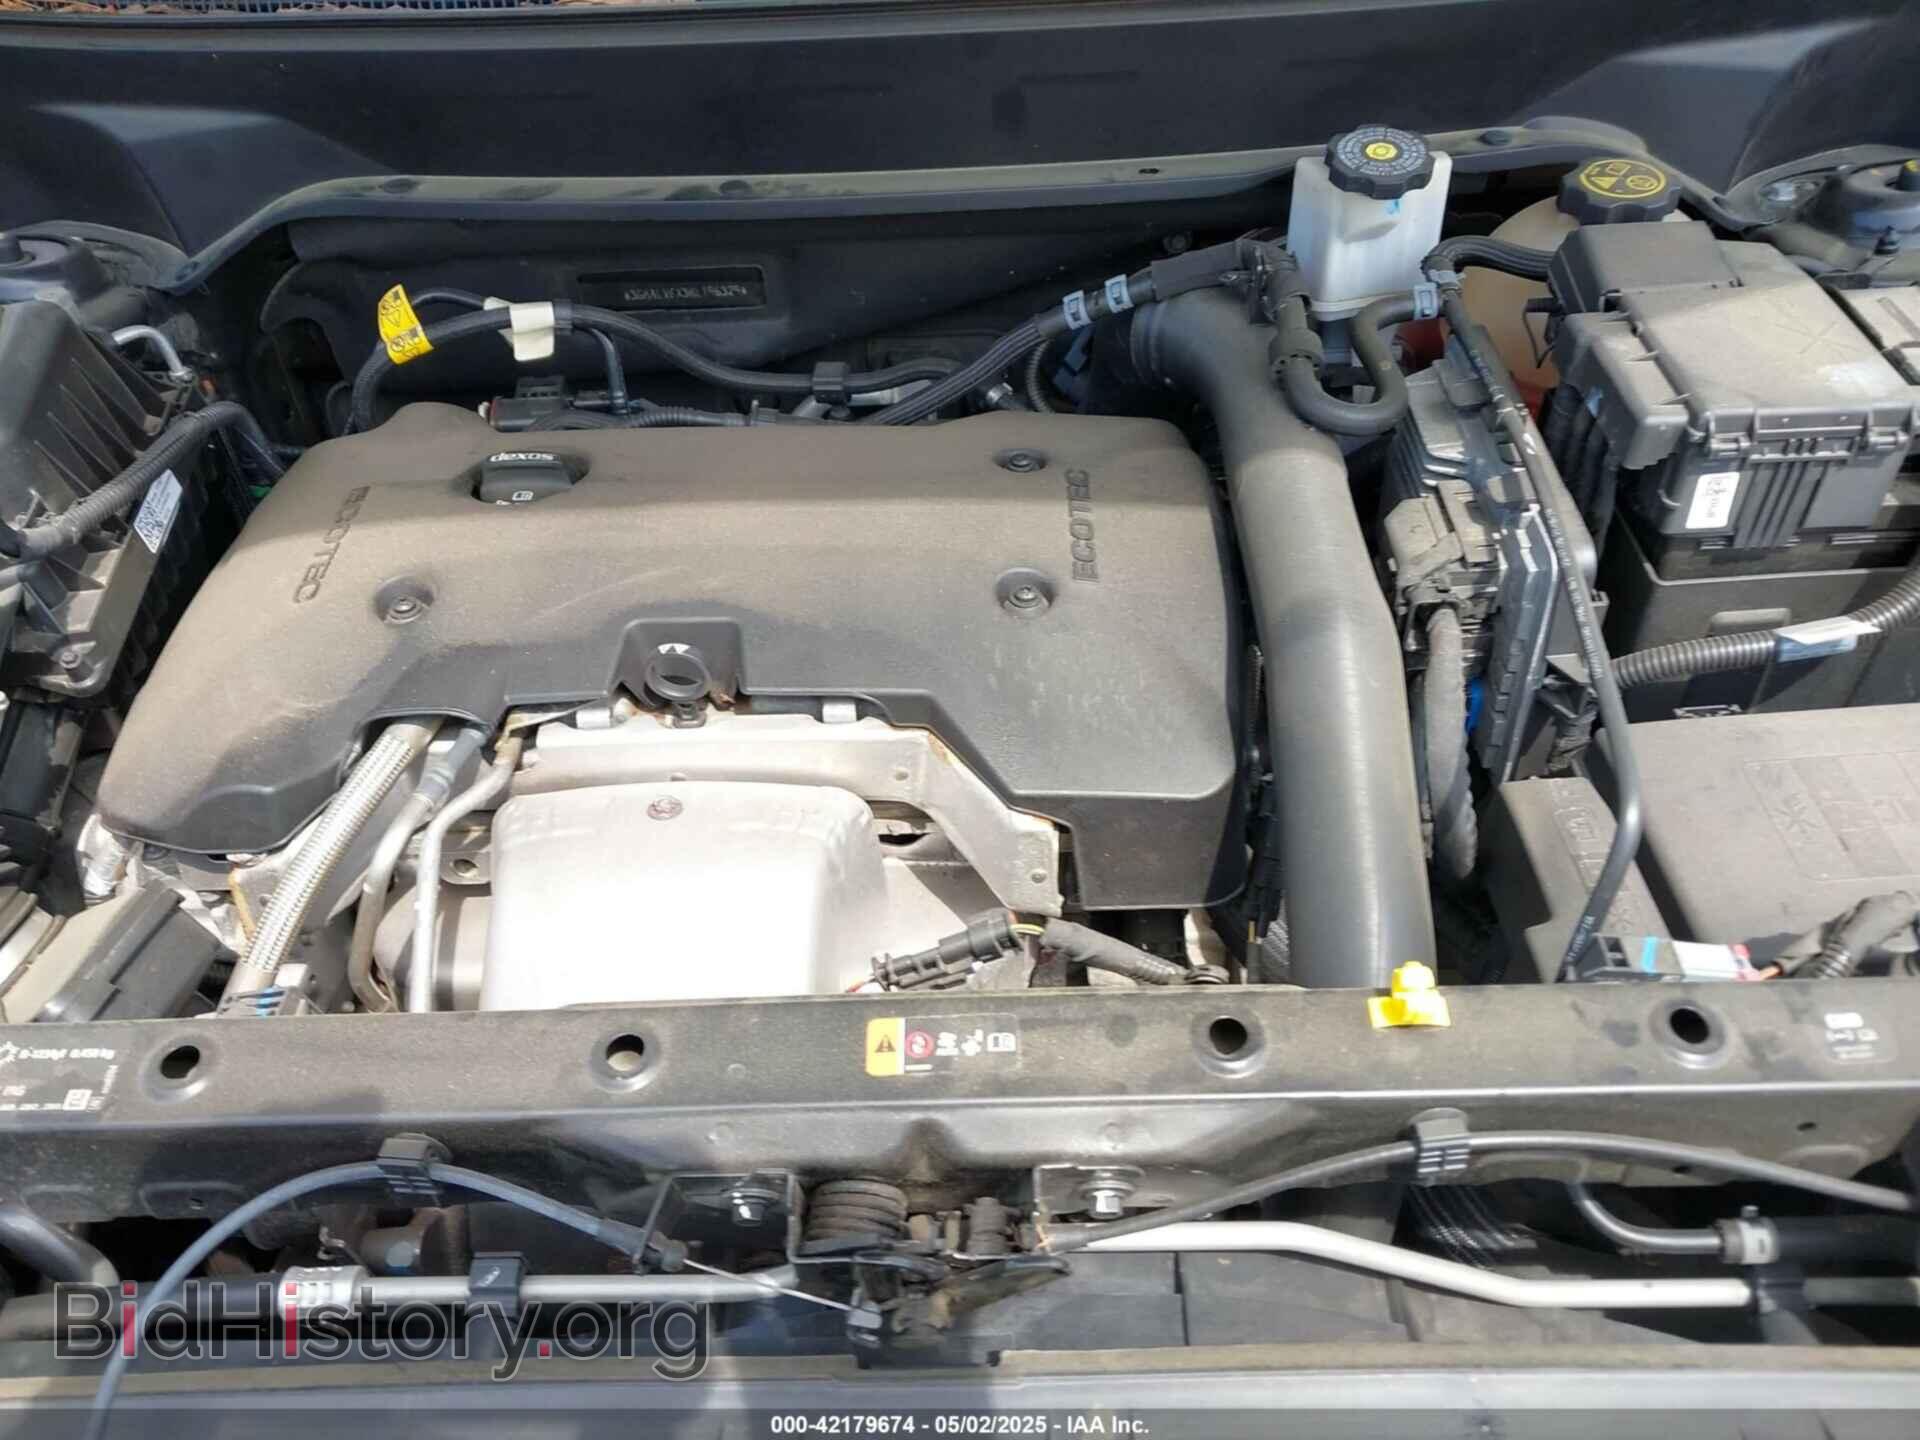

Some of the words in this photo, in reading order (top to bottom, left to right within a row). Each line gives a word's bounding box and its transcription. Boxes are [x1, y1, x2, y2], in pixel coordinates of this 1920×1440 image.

[489, 452, 556, 463] dexos
[292, 485, 371, 604] ECOTEC
[1064, 468, 1100, 582] ECOTEC
